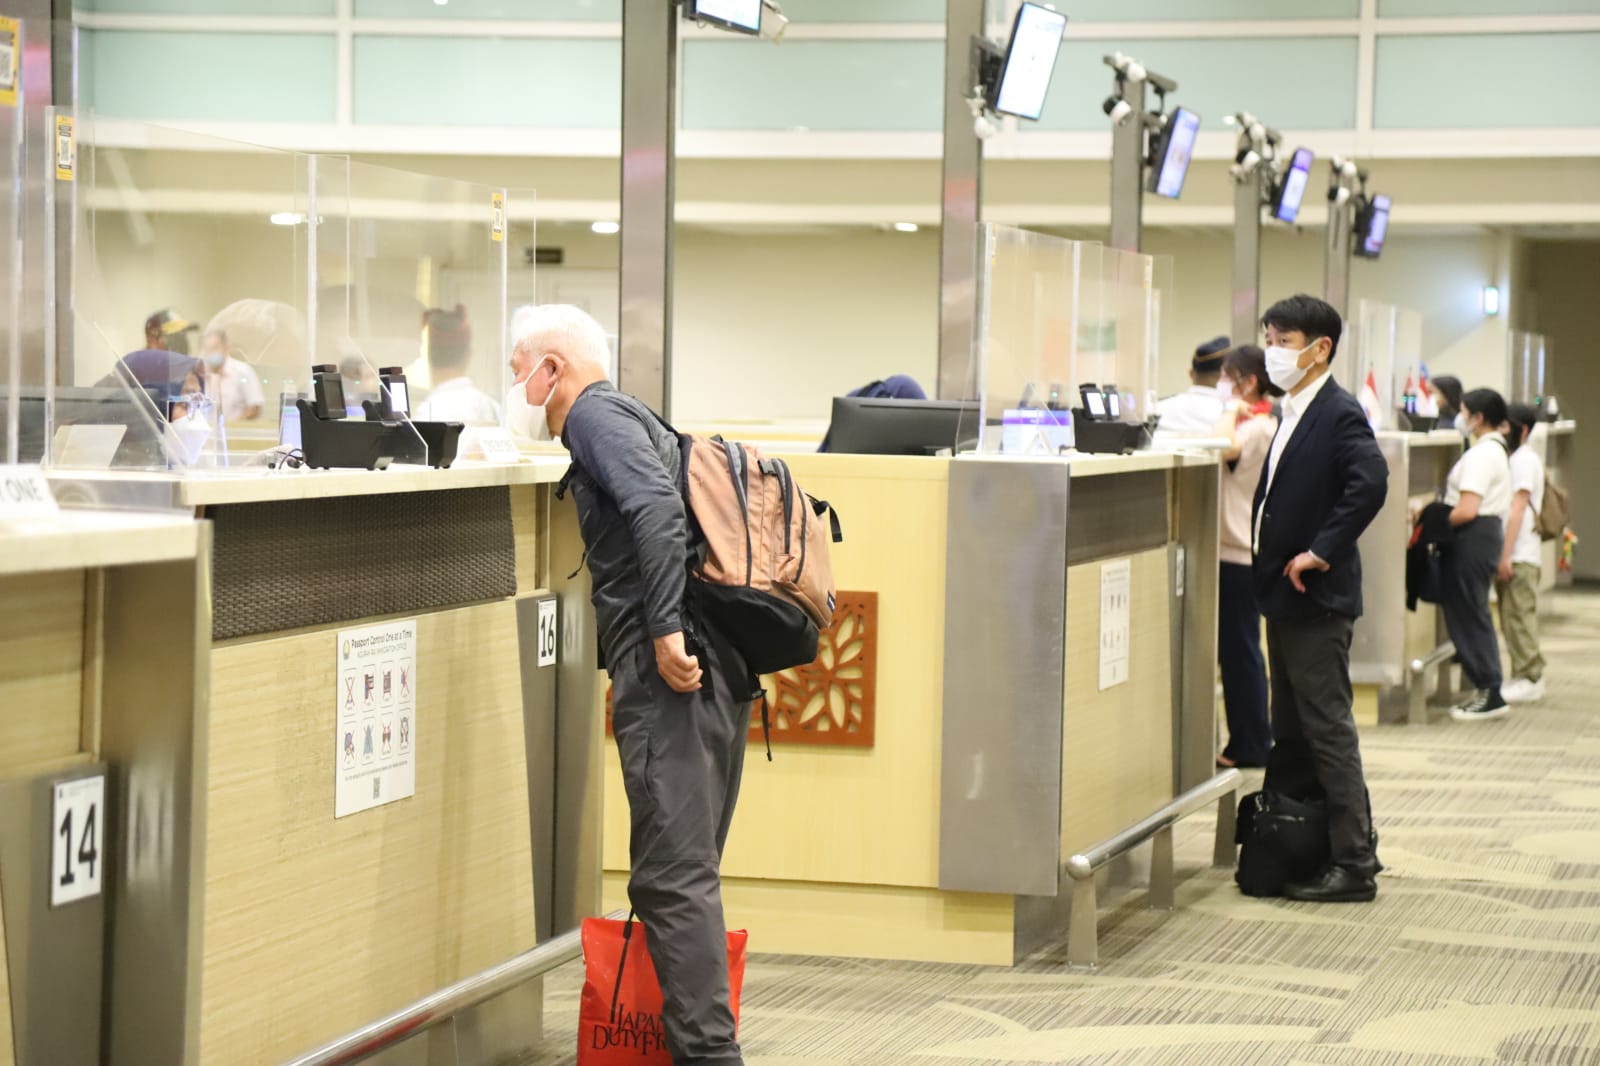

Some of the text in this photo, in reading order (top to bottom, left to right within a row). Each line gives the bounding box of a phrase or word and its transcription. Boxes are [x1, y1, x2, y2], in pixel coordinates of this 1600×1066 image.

[351, 638, 370, 649] Passport
[370, 635, 384, 646] Control
[386, 632, 394, 642] One
[402, 629, 412, 639] Time
[541, 613, 555, 657] 16
[60, 803, 97, 886] 14
[592, 1024, 666, 1055] DUTYFR
